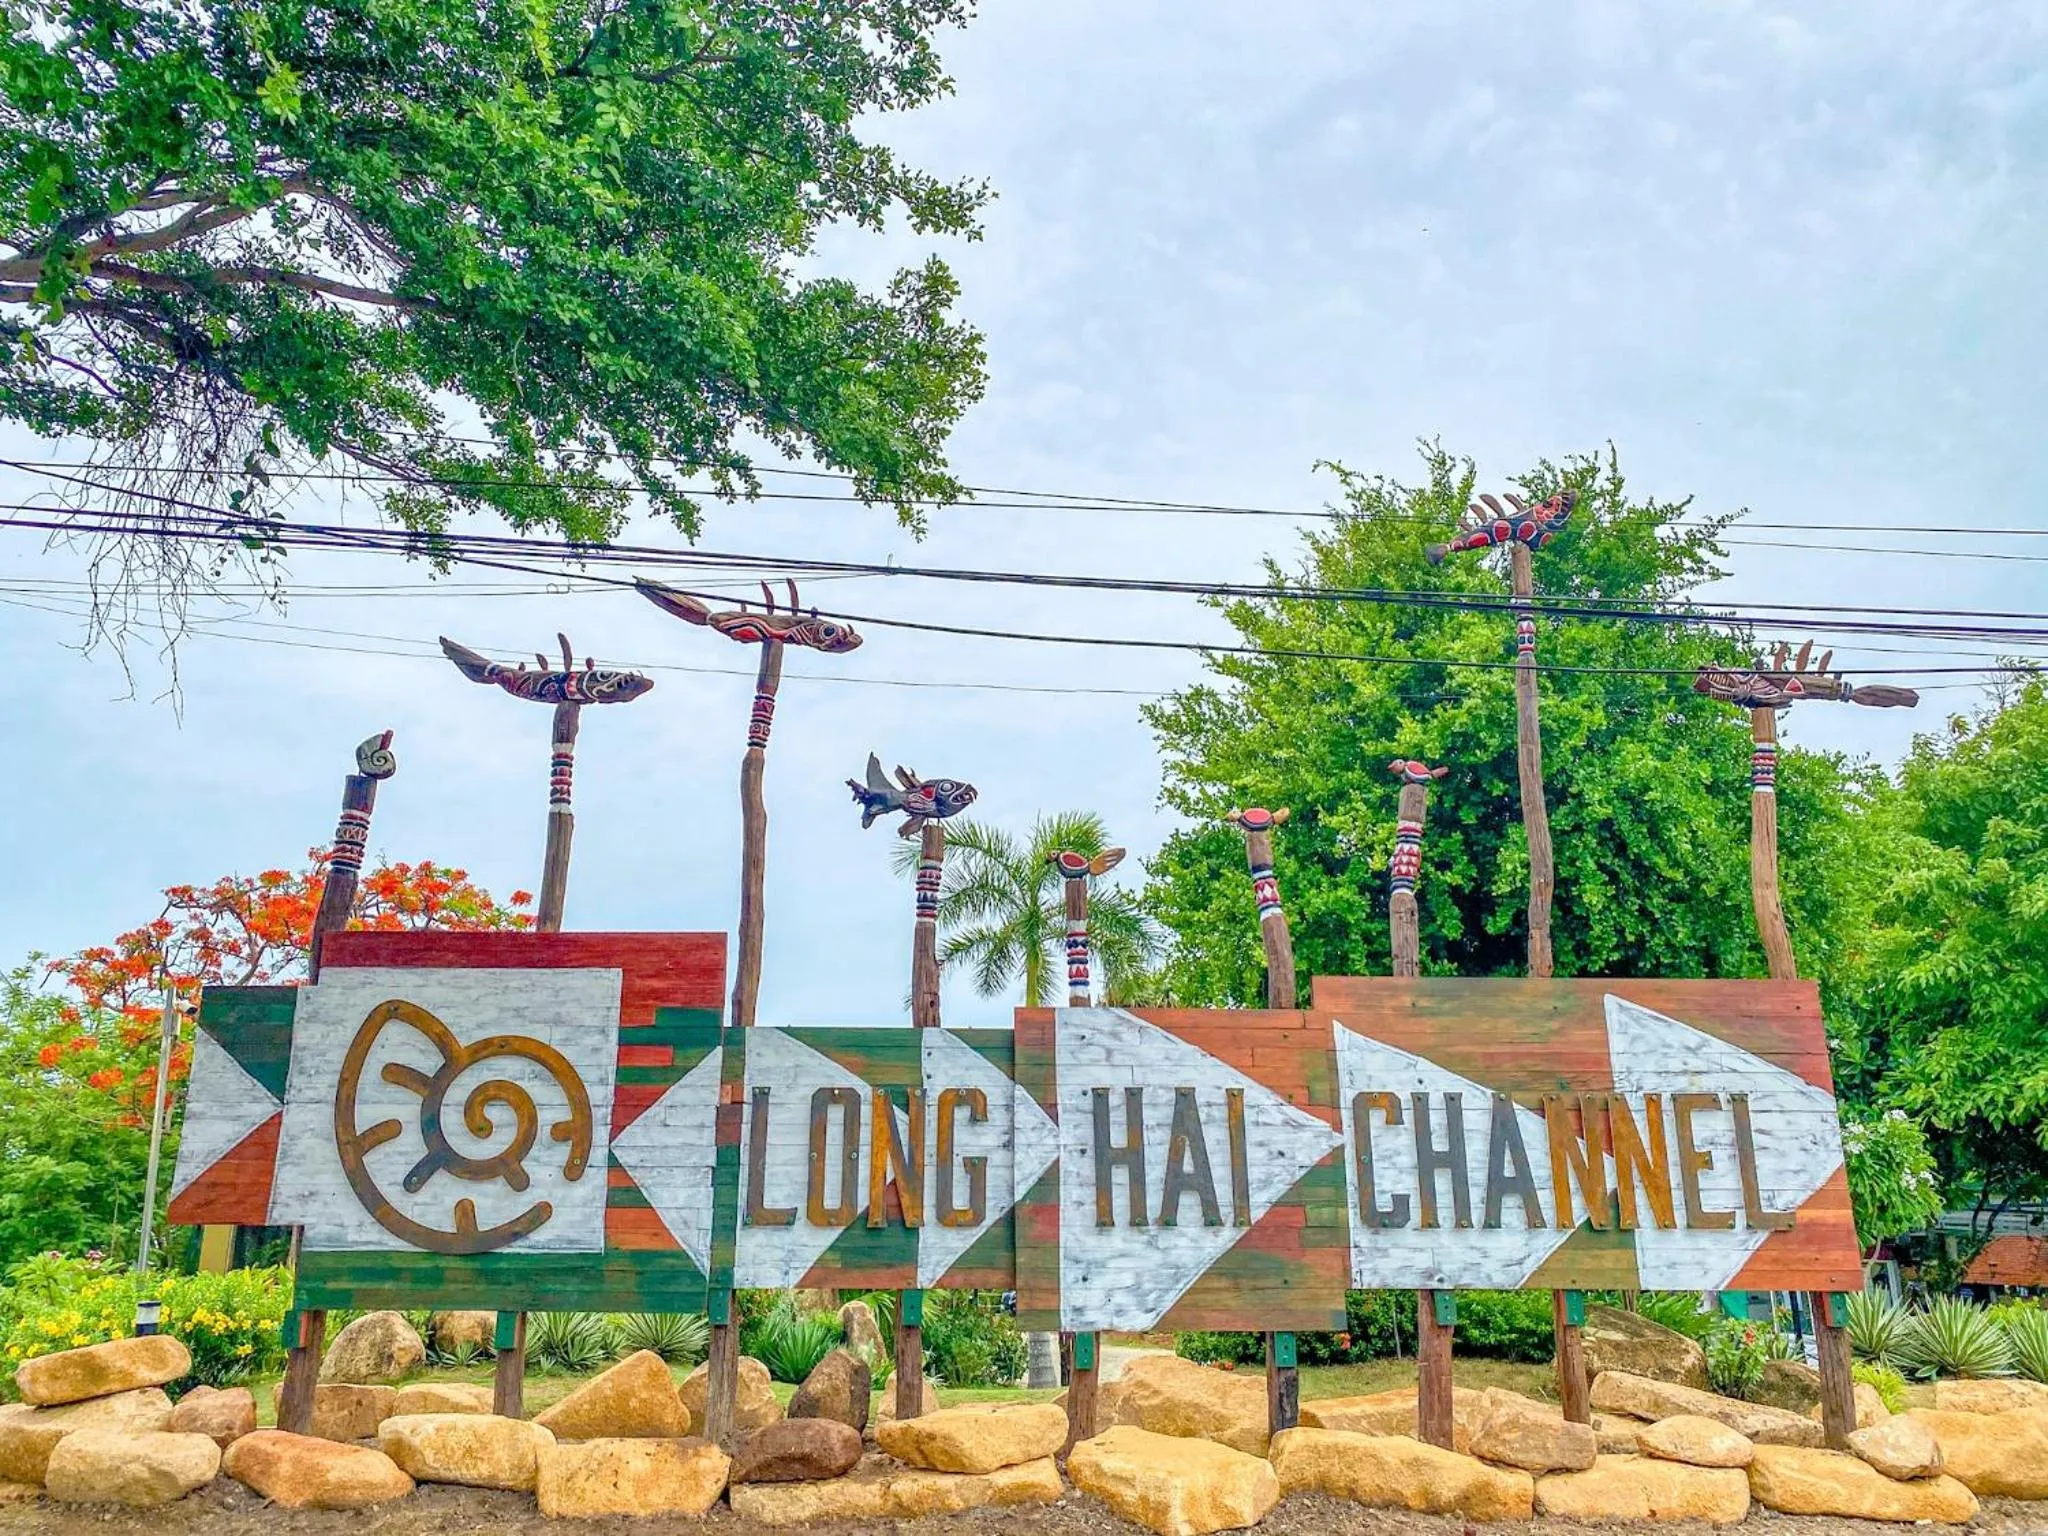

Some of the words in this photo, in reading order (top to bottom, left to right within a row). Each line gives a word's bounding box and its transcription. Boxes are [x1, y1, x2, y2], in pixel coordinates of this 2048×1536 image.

[744, 1086, 988, 1228] LONG
[1091, 1087, 1251, 1228] HAI
[1352, 1091, 1797, 1231] CHANNEL
